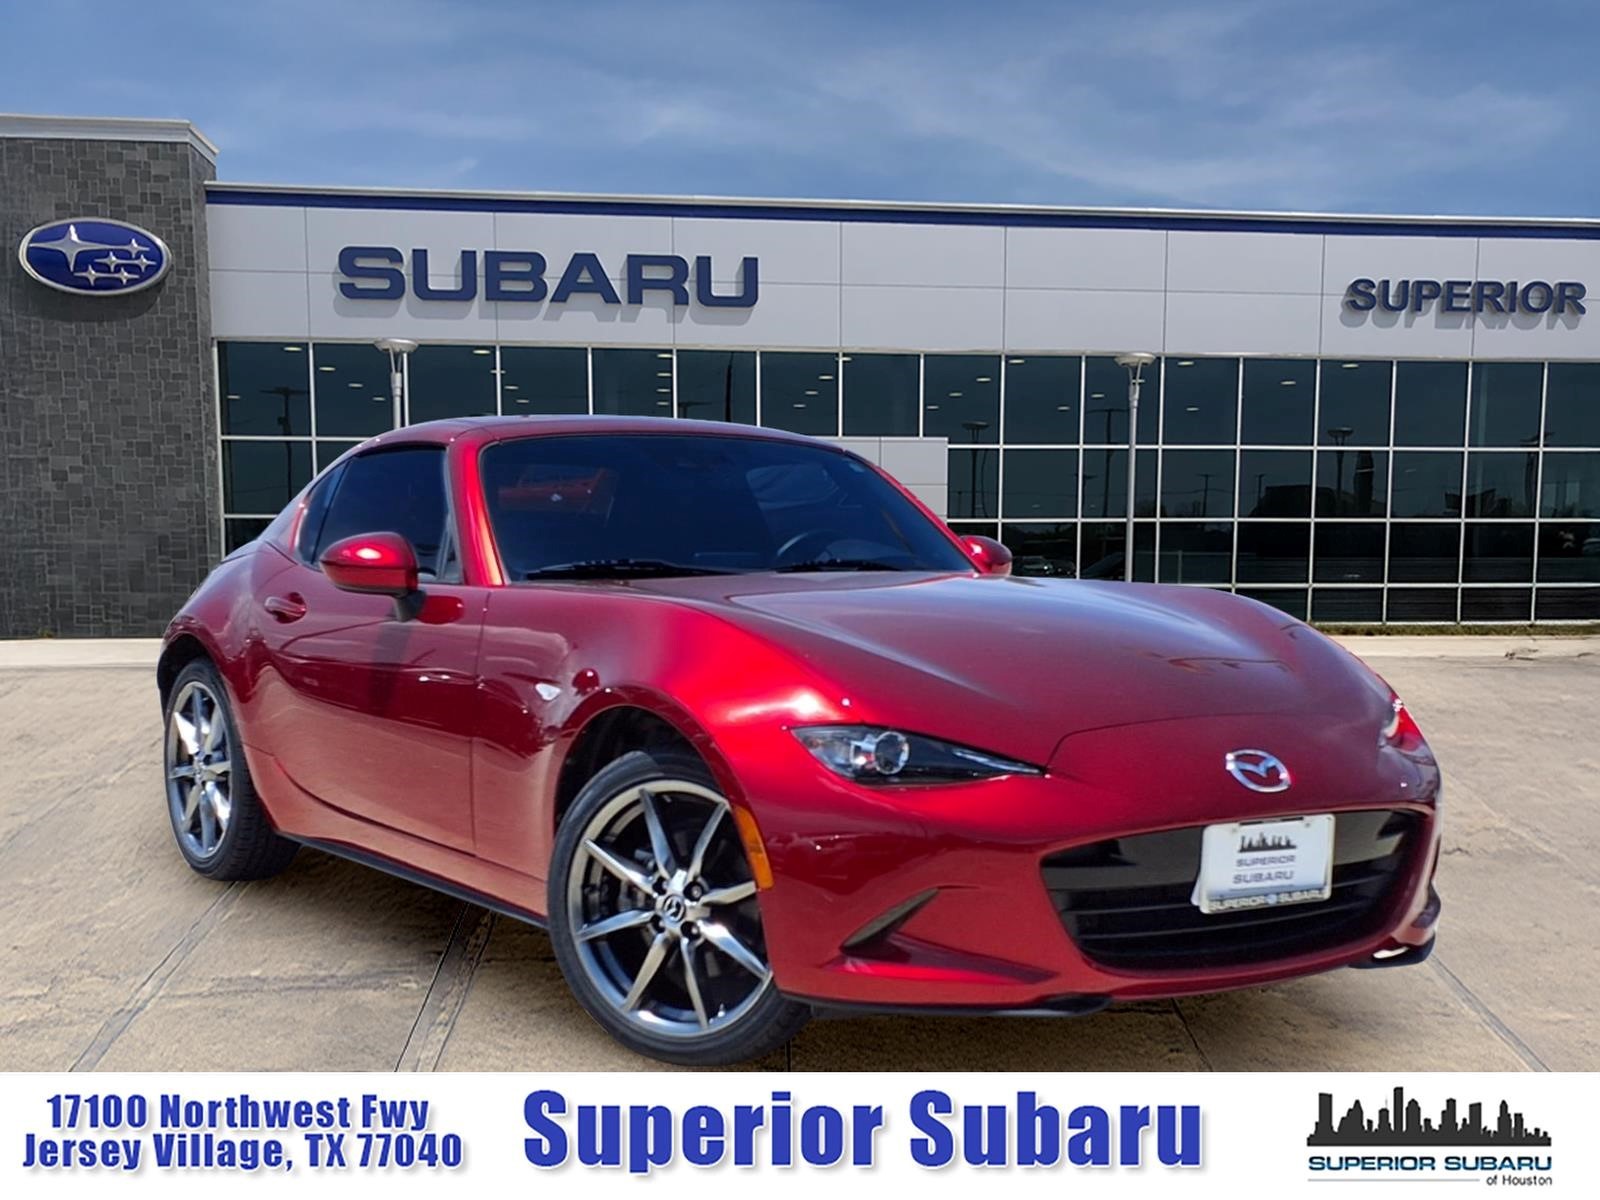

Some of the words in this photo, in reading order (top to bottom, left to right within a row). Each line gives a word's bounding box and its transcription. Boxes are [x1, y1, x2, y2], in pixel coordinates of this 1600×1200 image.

[338, 247, 758, 308] SUBARU
[1346, 278, 1587, 314] SUPERIOR
[1235, 854, 1296, 867] SUPERIOR
[1232, 871, 1295, 884] SUBARU
